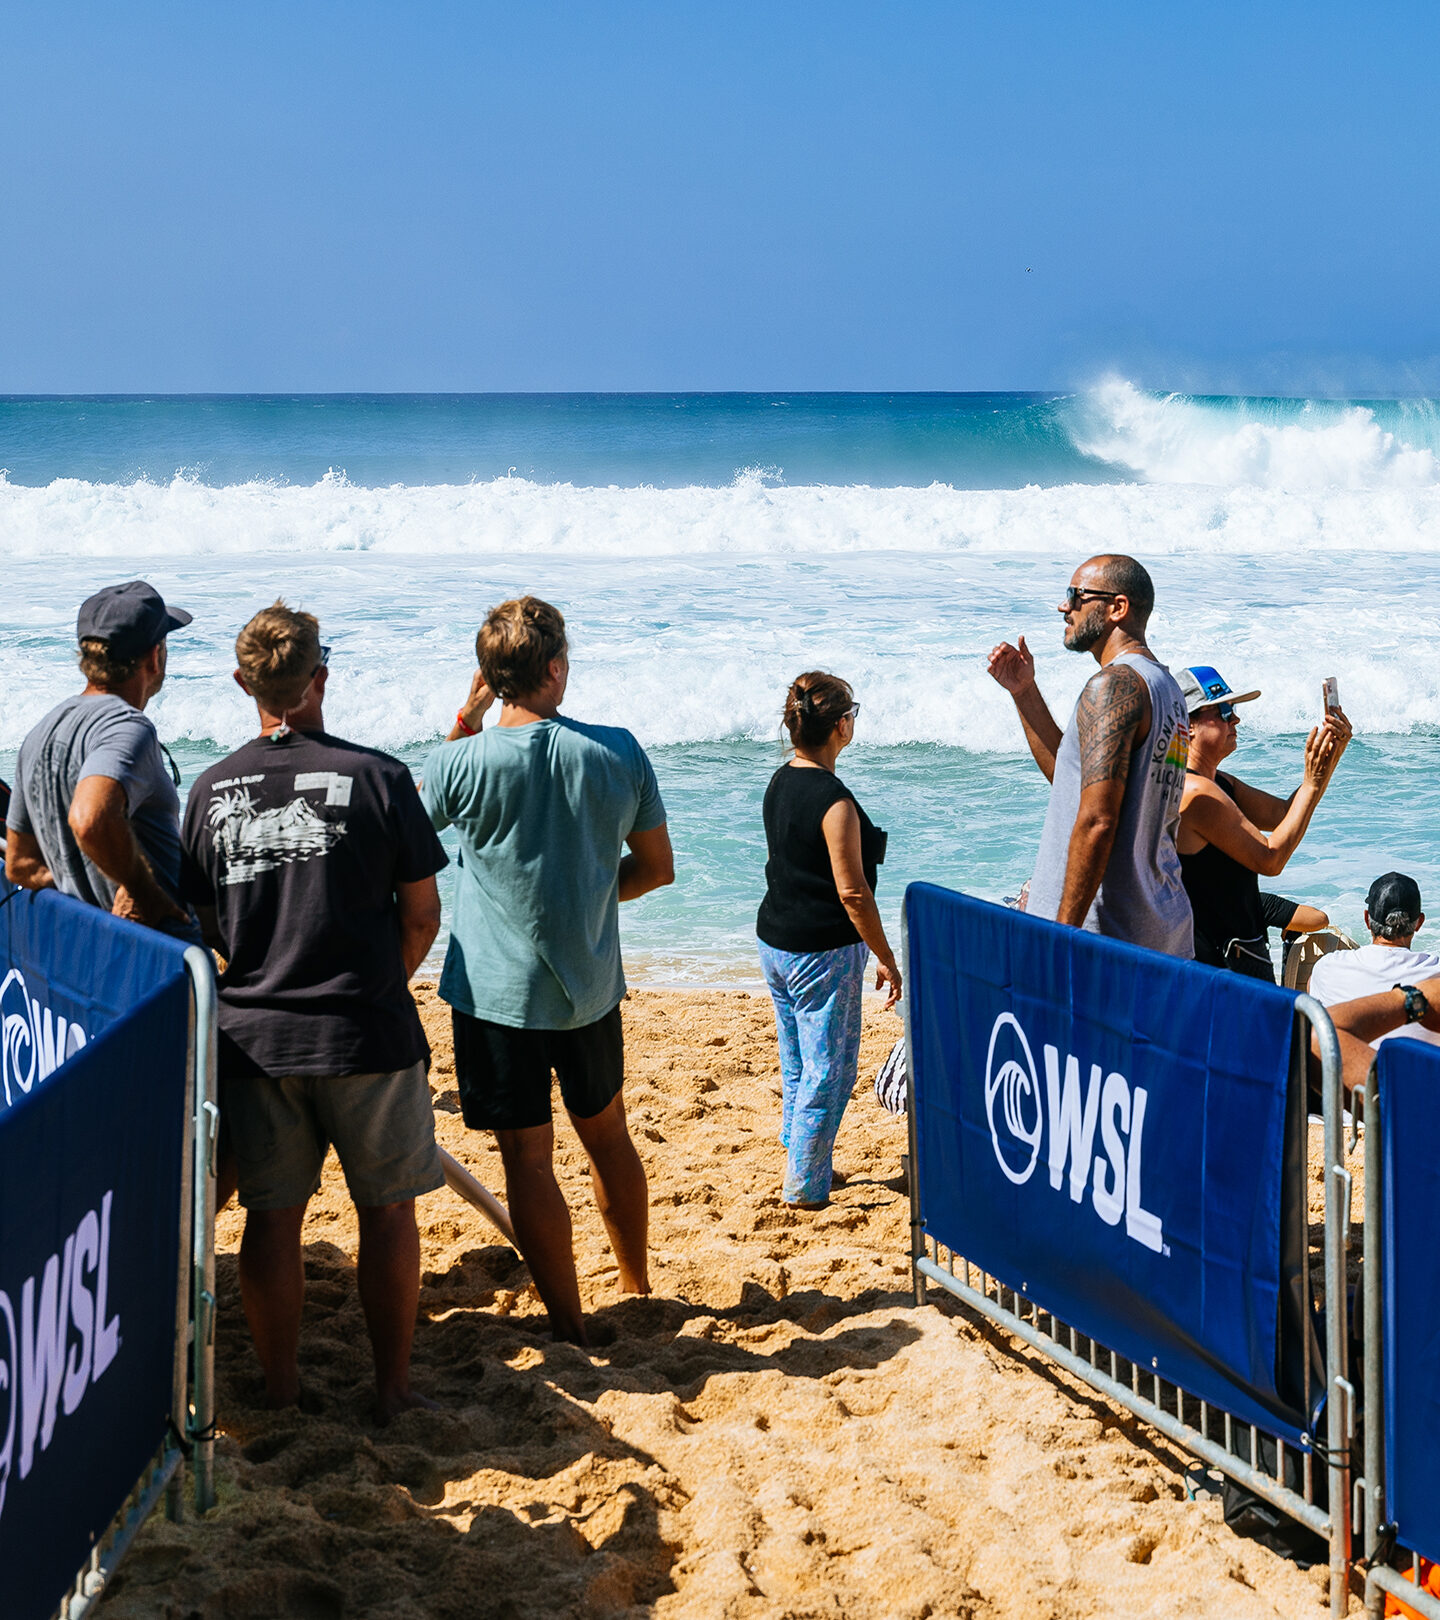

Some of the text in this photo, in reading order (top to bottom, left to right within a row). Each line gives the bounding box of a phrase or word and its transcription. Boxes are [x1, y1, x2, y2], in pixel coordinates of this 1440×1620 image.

[1152, 714, 1175, 763] KONA
[1044, 1043, 1163, 1254] WSL
[19, 1190, 120, 1480] WSL
